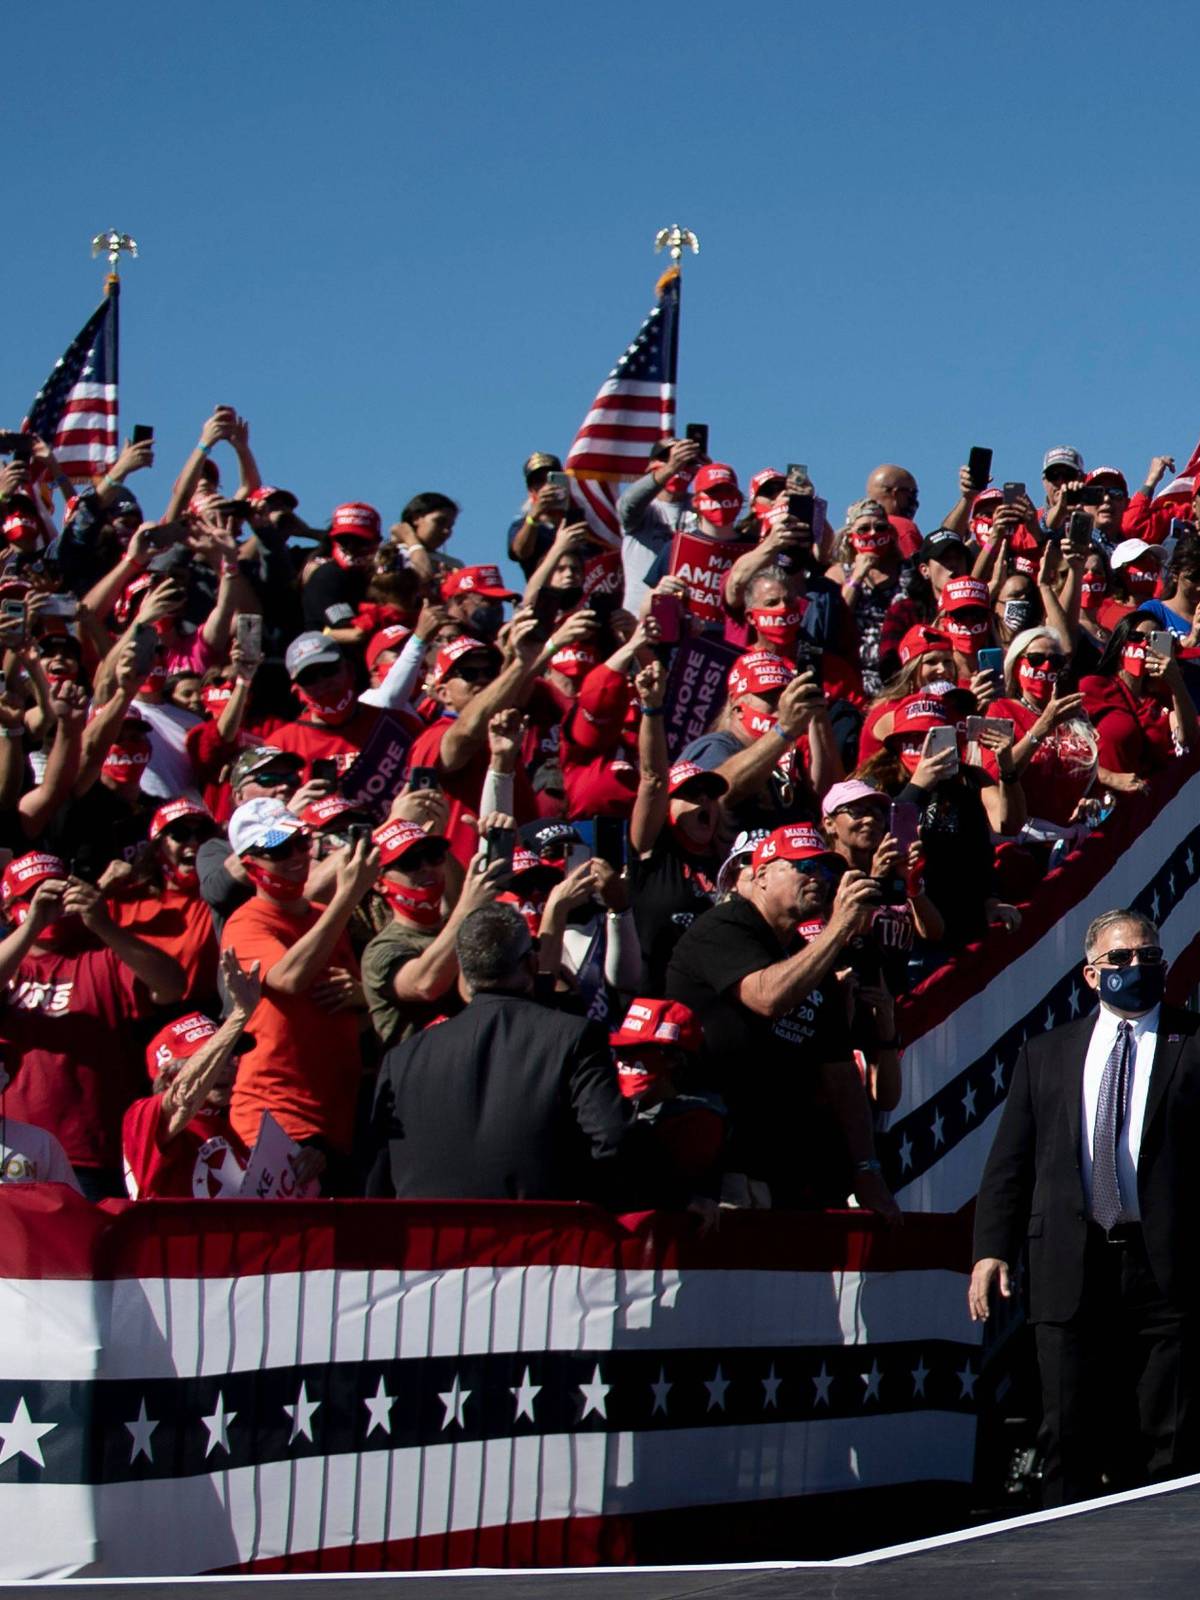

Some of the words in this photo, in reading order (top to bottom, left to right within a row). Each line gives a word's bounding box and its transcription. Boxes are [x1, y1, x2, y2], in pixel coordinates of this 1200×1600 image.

[699, 498, 739, 511] MAGA
[708, 554, 735, 570] MA
[687, 586, 722, 608] REAT
[1121, 645, 1146, 659] MA
[1020, 664, 1057, 682] MAG
[207, 688, 233, 701] MA
[670, 649, 706, 728] MORE
[355, 740, 406, 808] MORE
[760, 840, 777, 858] 45
